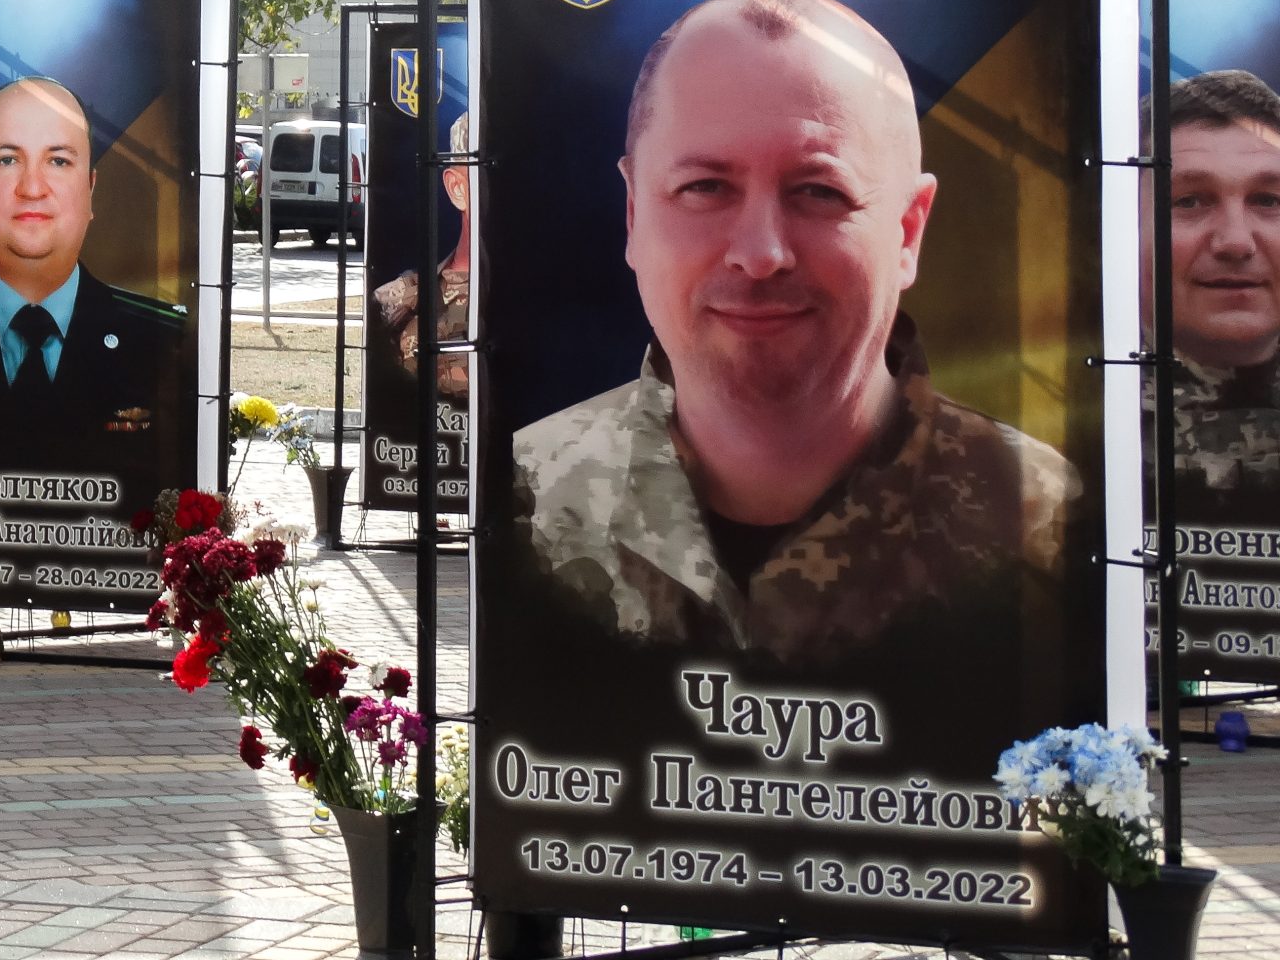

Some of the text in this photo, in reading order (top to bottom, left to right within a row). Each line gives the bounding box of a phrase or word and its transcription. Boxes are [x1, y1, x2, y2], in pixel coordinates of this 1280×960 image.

[35, 567, 160, 591] 28.04.2022
[1181, 571, 1280, 609] Анато
[1217, 632, 1280, 656] 09.1
[682, 672, 882, 761] Чаура
[495, 744, 621, 806] Олег
[521, 840, 748, 886] 13.07.1974
[794, 859, 1034, 907] 13.03.2022
